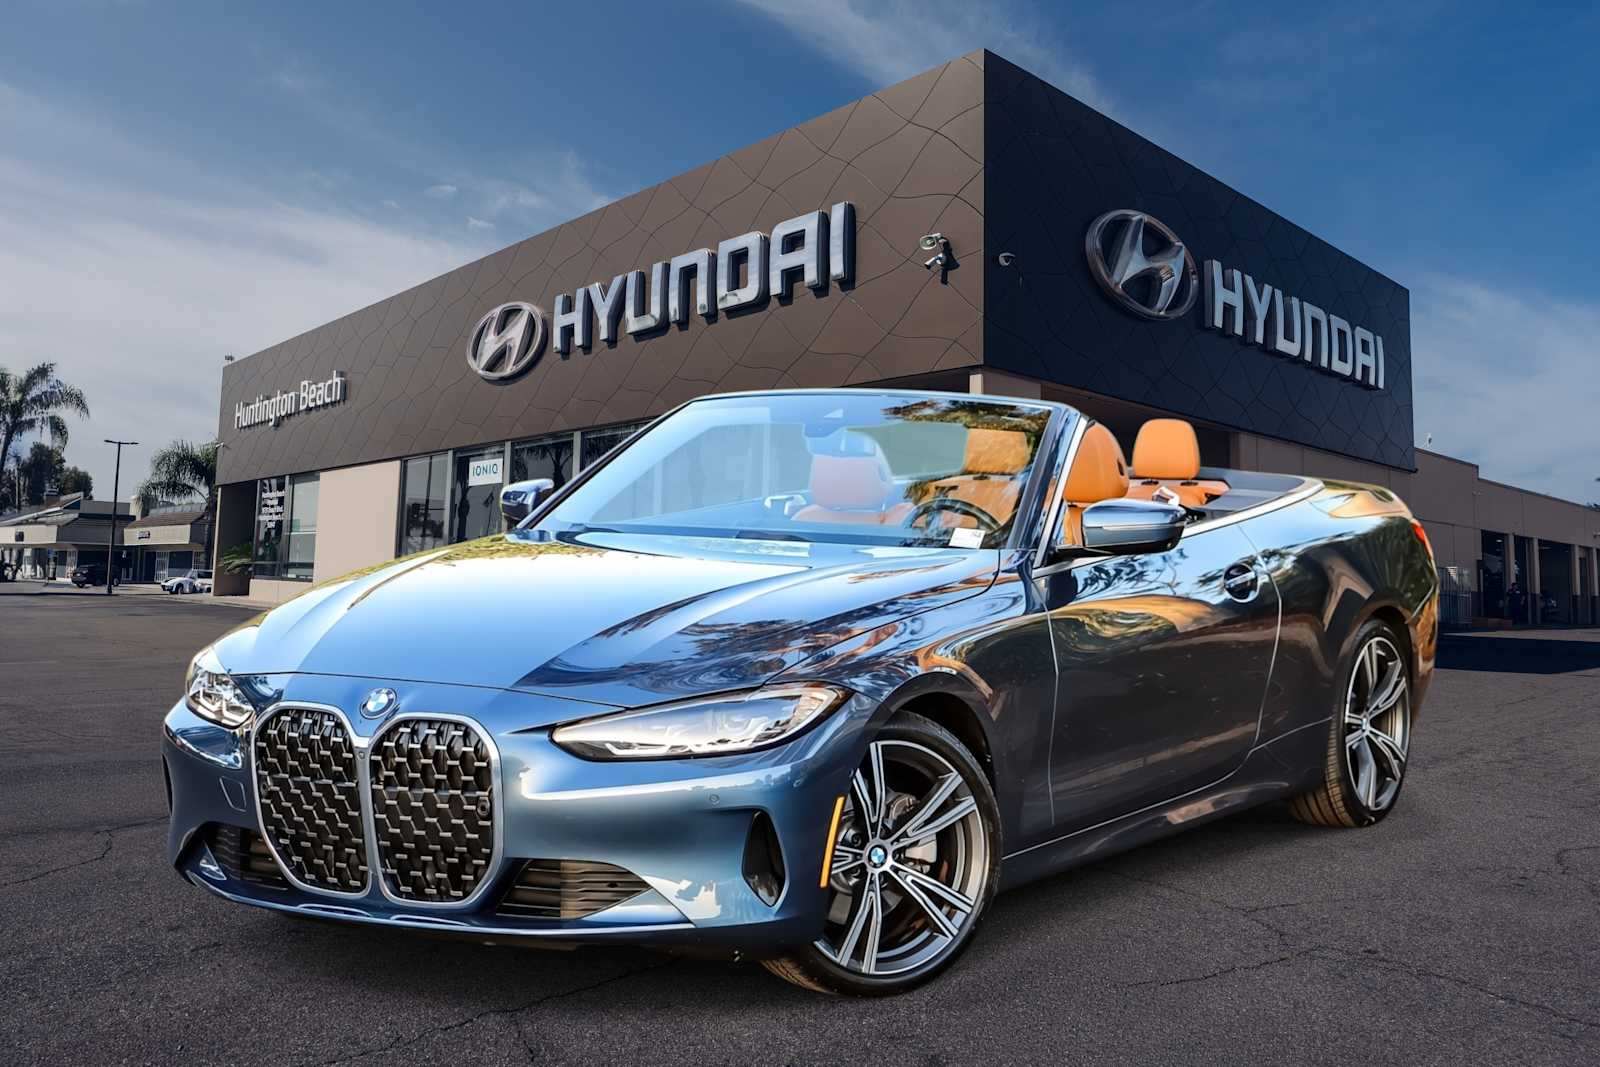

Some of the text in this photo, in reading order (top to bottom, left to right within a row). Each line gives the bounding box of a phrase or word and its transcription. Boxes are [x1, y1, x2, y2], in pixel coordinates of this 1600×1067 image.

[553, 201, 853, 355] HYUNDAI
[1204, 258, 1385, 389] HYUNDAI
[234, 370, 344, 429] Huntington Beach
